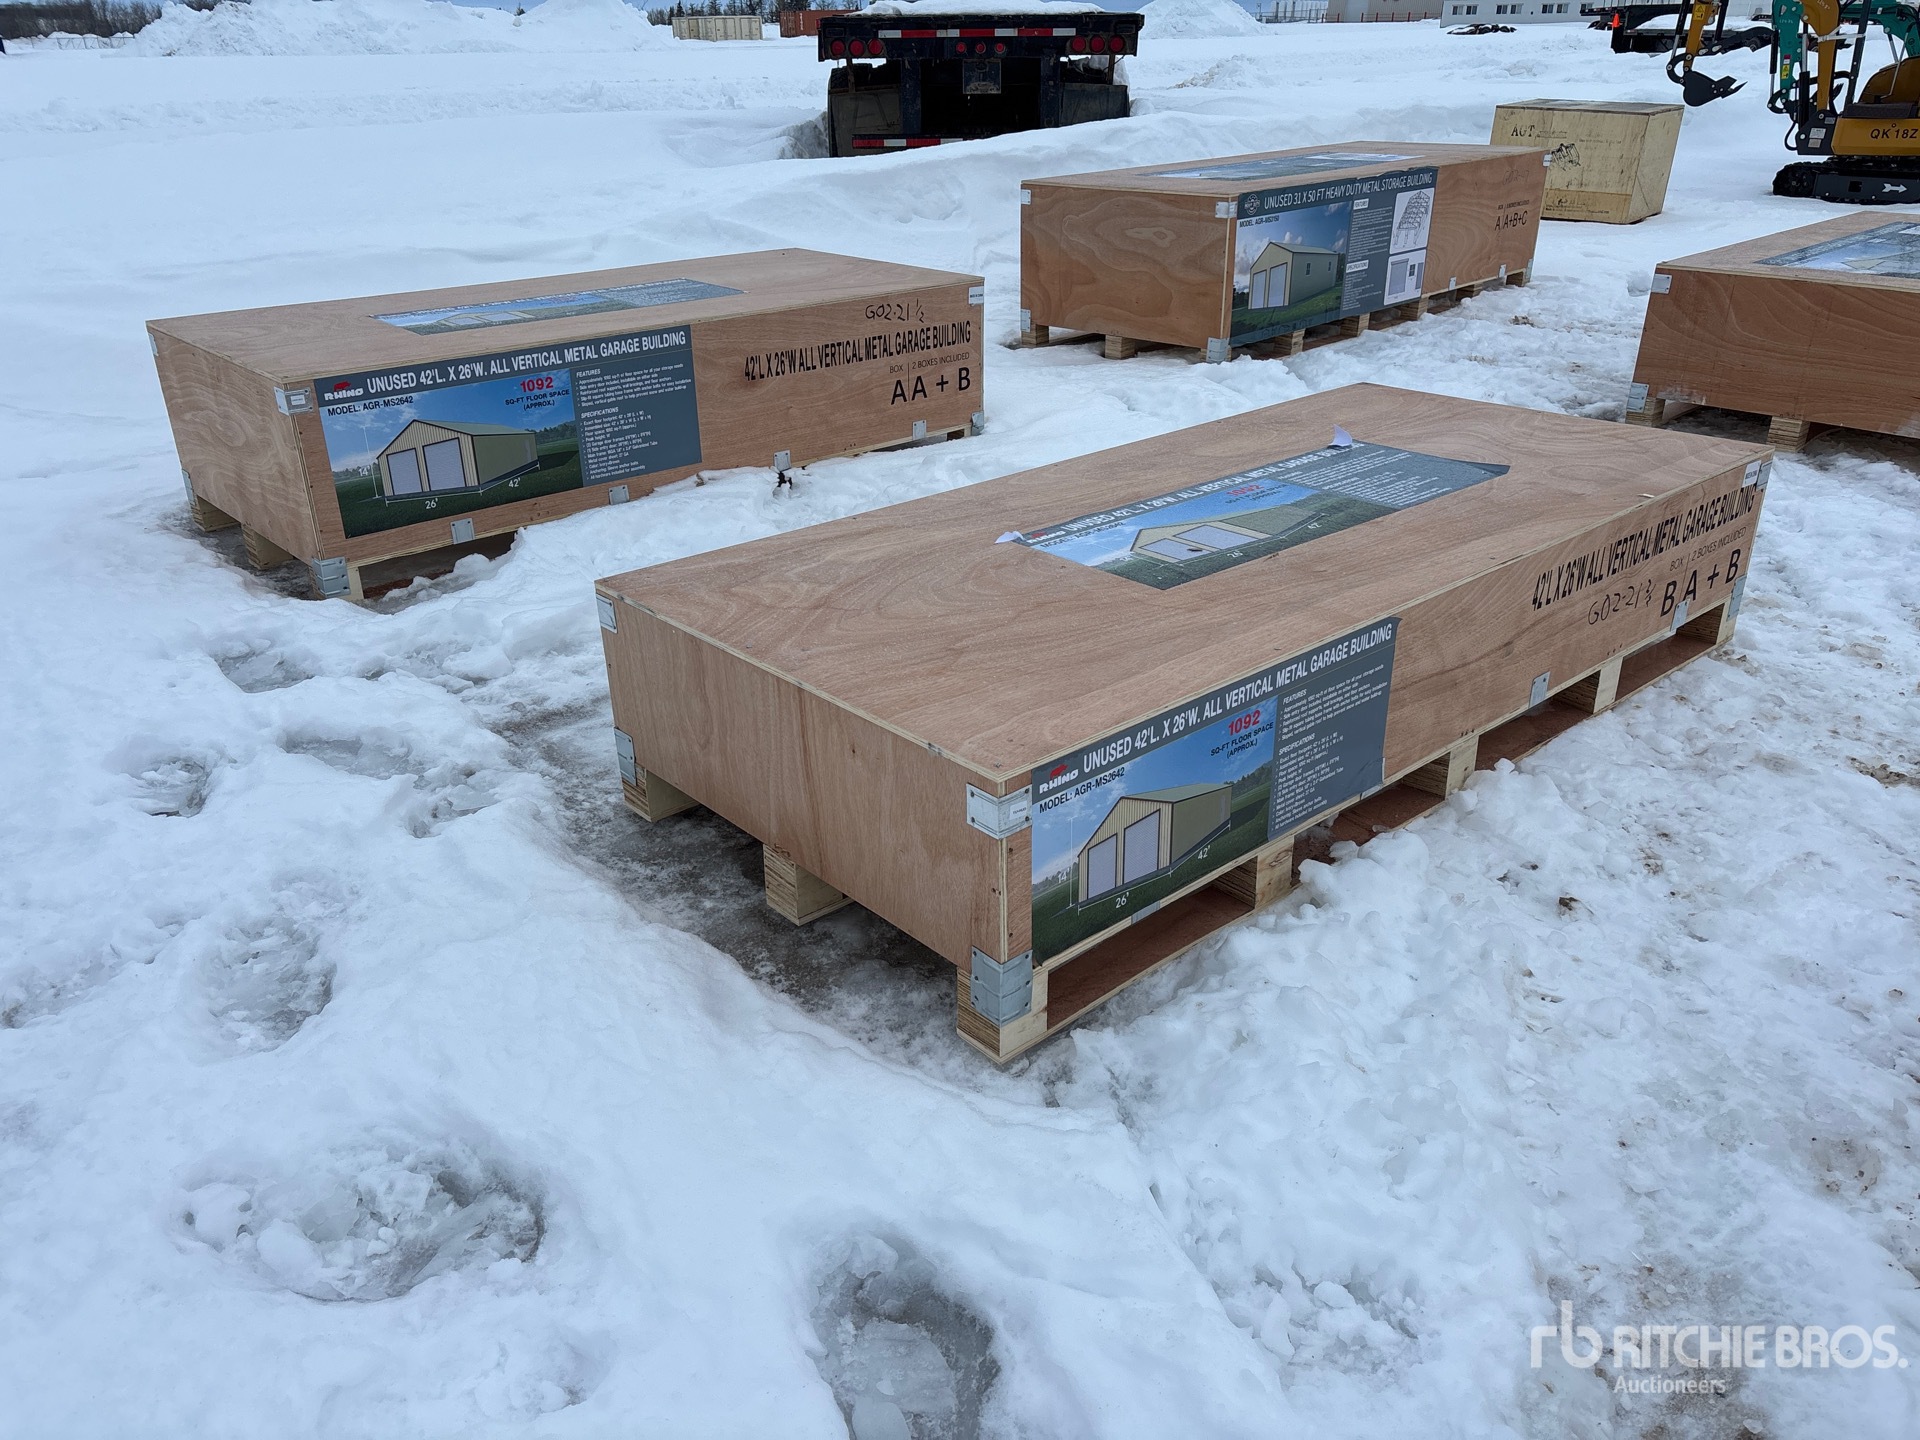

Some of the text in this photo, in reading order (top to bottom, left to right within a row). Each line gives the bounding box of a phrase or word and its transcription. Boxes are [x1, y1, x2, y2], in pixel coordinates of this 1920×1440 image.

[1264, 172, 1433, 210] UNUSED 31 X 50 FT HEAVY DUTY METAL STORAGE BUILDING
[1494, 215, 1501, 231] A
[366, 371, 416, 393] UNUSED
[447, 365, 456, 380] X
[488, 357, 509, 374] ALL
[511, 349, 562, 371] VERTICAL
[564, 344, 598, 362] METAL
[599, 337, 639, 357] GARAGE
[641, 330, 685, 350] BUILDING
[744, 320, 971, 381] 42'L X 26'W ALL VERTICAL METAL GARAGE BUILDING
[889, 352, 970, 374] BOX 2 BOXES INCLUDED
[519, 376, 553, 392] 1092
[576, 368, 600, 377] FEATURES
[911, 366, 971, 401] A + B
[505, 388, 569, 405] SQ-FT FLOOR SPACE
[891, 379, 908, 405] A
[327, 395, 413, 416] MODEL: AGR-MS2642
[580, 406, 618, 418] SPECIFICATIONS
[507, 477, 521, 488] 42'
[424, 497, 439, 509] 26'
[1061, 513, 1115, 531] UNUSED
[1552, 564, 1565, 602] X
[1585, 546, 1606, 588] ALL
[1606, 526, 1653, 577] VERTICAL
[1651, 513, 1683, 557] METAL
[1682, 496, 1721, 543] GARAGE
[1717, 484, 1757, 527] BUILDING
[1669, 526, 1746, 572] BOX 2 BOXES INCLUDED
[1683, 548, 1741, 601] A + B
[1660, 580, 1677, 617] B
[1083, 735, 1131, 773] UNUSED
[1162, 718, 1170, 738] X
[1203, 695, 1222, 720] ALL
[1225, 673, 1273, 711] VERTICAL
[1276, 658, 1308, 688] METAL
[1310, 641, 1348, 673] GARAGE
[1349, 622, 1392, 656] BUILDING
[1282, 688, 1306, 705] FEATURES
[1228, 708, 1260, 737] 1092
[1210, 721, 1273, 757] SQ-FT FLOOR SPACE
[1278, 732, 1315, 756] SPECIFICATIONS
[1039, 768, 1078, 794] RHINO
[1040, 766, 1124, 813] MODEL: AGR-MS2642
[1198, 844, 1210, 861] 42'
[1115, 891, 1129, 909] 26'
